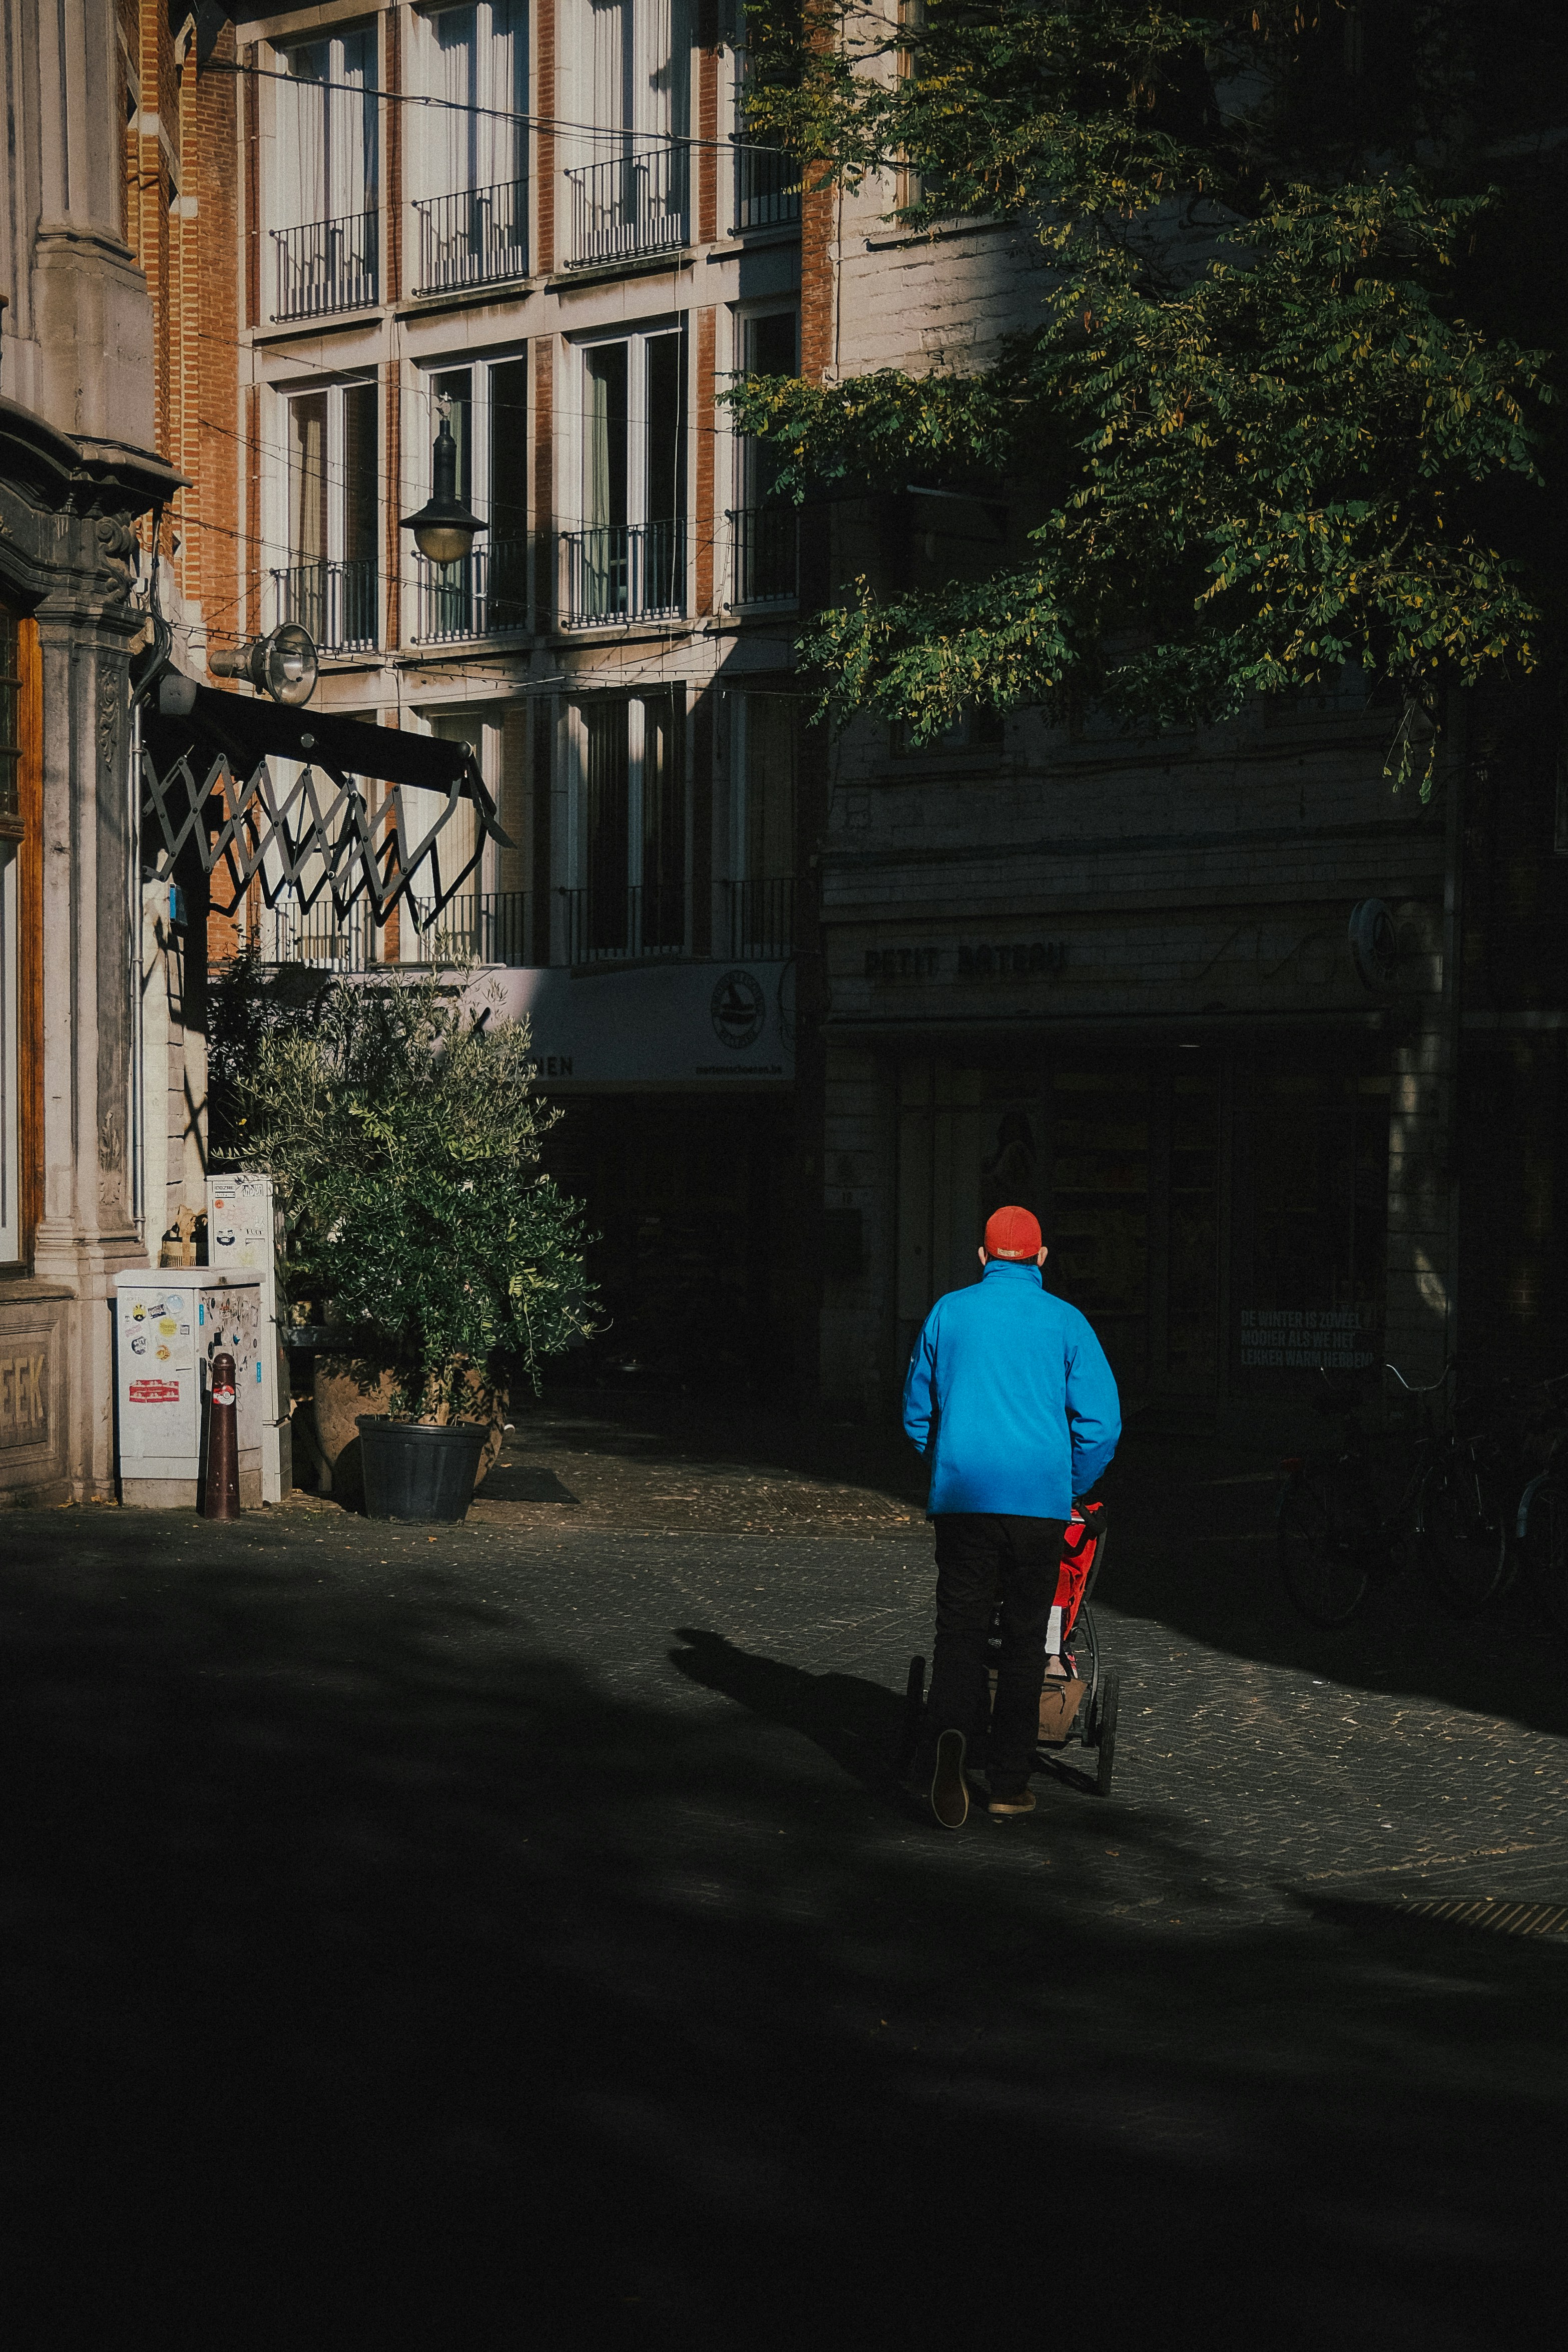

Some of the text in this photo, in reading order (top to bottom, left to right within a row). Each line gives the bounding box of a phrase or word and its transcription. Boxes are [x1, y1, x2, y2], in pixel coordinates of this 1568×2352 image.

[864, 947, 939, 979] PETIT
[524, 1056, 573, 1076] NEN
[1241, 1310, 1256, 1327] DE
[1258, 1310, 1303, 1327] WINTER
[1305, 1311, 1317, 1328] IS
[1241, 1329, 1356, 1348] MOOIER ALS WE HET
[1241, 1349, 1284, 1365] LEKKER
[1285, 1350, 1322, 1367] WARM
